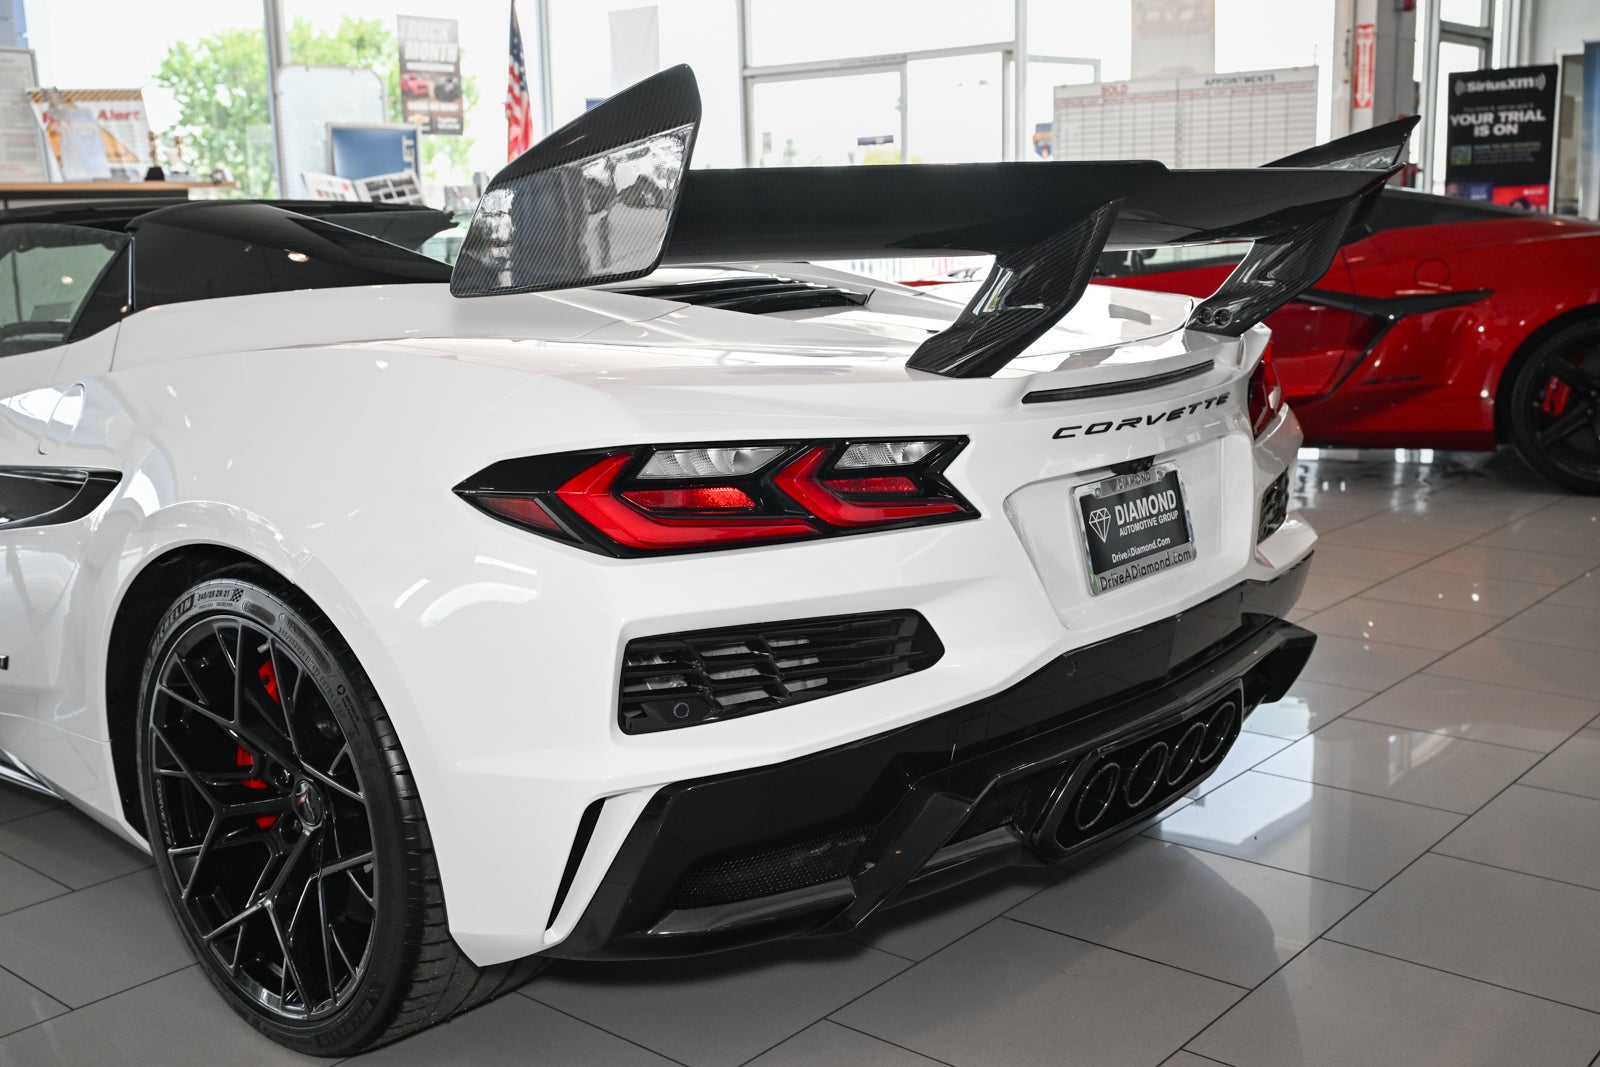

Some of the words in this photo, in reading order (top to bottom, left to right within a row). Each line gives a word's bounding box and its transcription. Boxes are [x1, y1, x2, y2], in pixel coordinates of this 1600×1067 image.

[1101, 84, 1128, 96] SOLD
[1204, 74, 1276, 86] APPOINTMENTS
[98, 109, 141, 121] Alert
[1450, 112, 1494, 127] YOUR
[1498, 109, 1546, 124] TRIAL
[1473, 125, 1490, 138] IS
[1493, 123, 1519, 136] ON
[1052, 392, 1231, 440] CORVETTE
[1116, 471, 1151, 490] DIAMOND
[1114, 489, 1178, 527] DIAMOND
[1119, 516, 1158, 538] AUTOMOTIVE
[1158, 510, 1179, 527] GROUP
[1111, 536, 1172, 564] DriveADiamond.Com
[1099, 549, 1192, 592] DriveADiamond.com
[150, 596, 194, 657] MICHELIN
